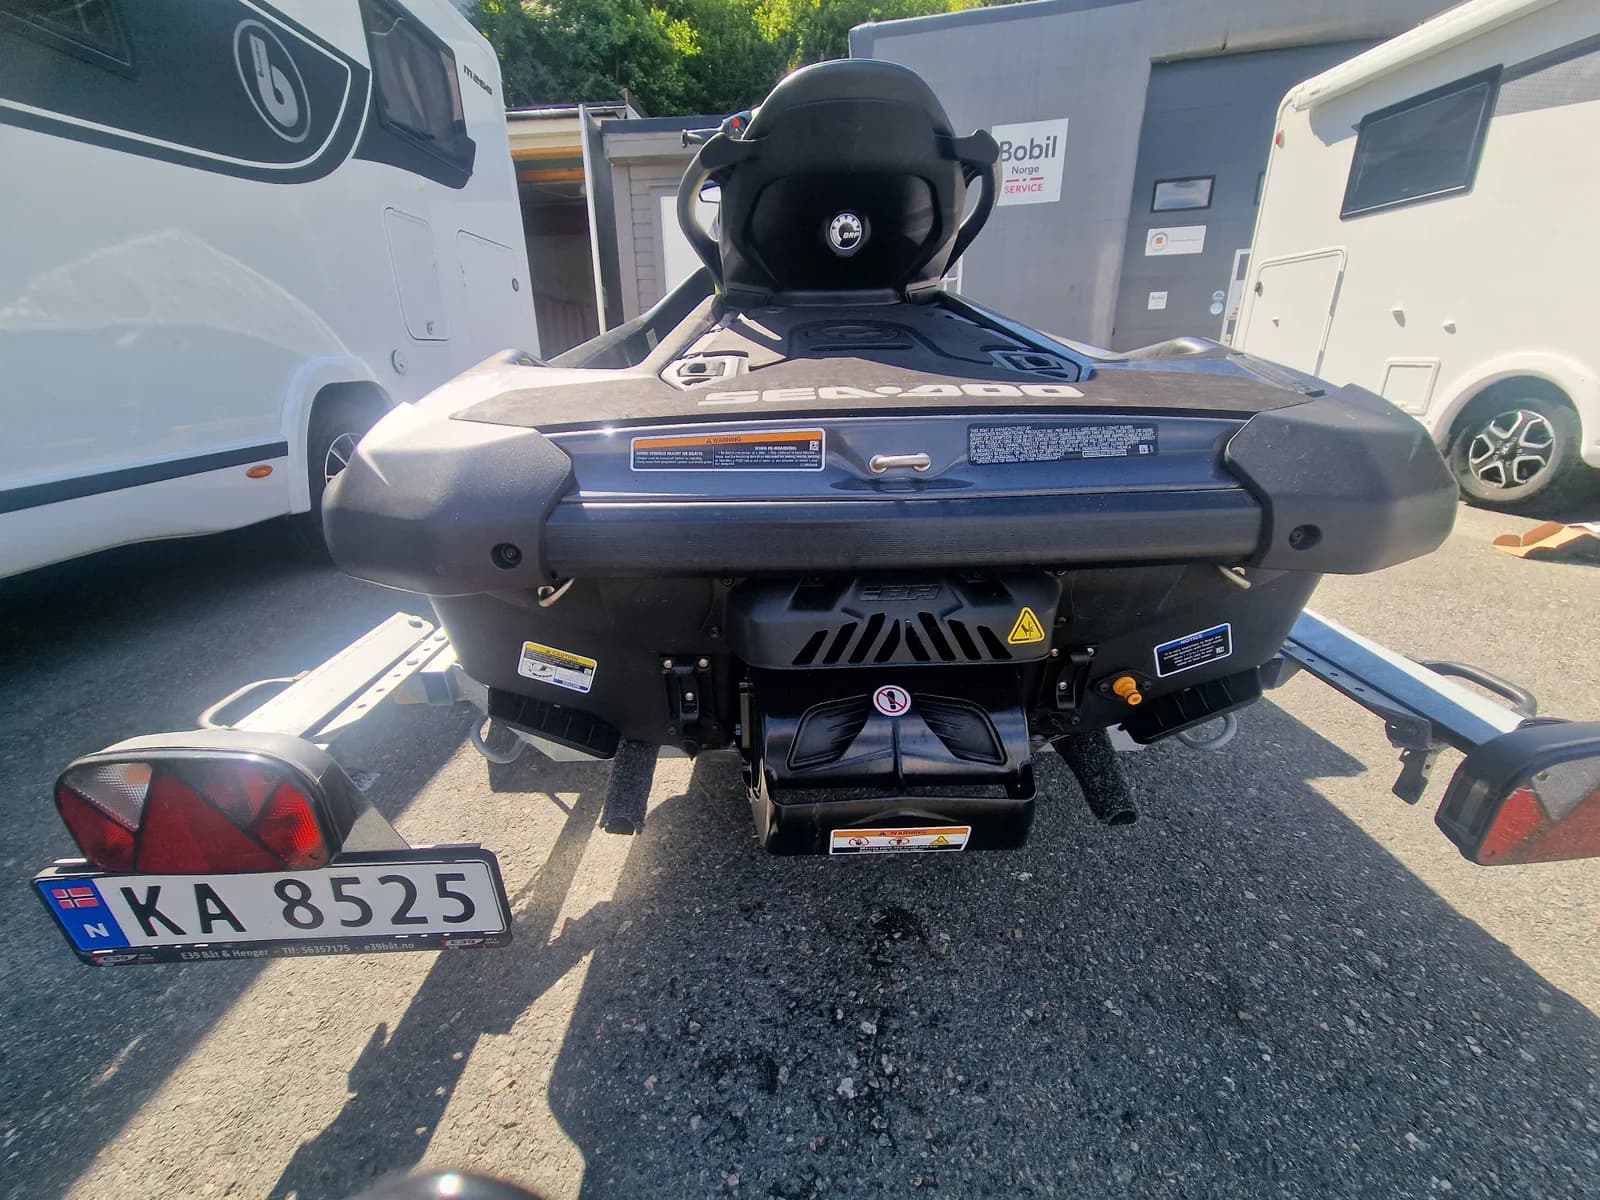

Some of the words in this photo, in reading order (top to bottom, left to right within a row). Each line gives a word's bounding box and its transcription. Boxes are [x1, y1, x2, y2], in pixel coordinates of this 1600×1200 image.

[1000, 135, 1058, 162] Bobil
[1011, 165, 1040, 176] Norge
[1004, 183, 1044, 195] SERVICE
[712, 436, 742, 444] WARNING
[1180, 634, 1203, 644] NOTICE
[119, 882, 247, 938] KA
[272, 872, 476, 931] 8525
[82, 923, 110, 940] N
[181, 951, 200, 960] E39
[233, 948, 269, 958] Henger
[303, 944, 351, 954] 56357175
